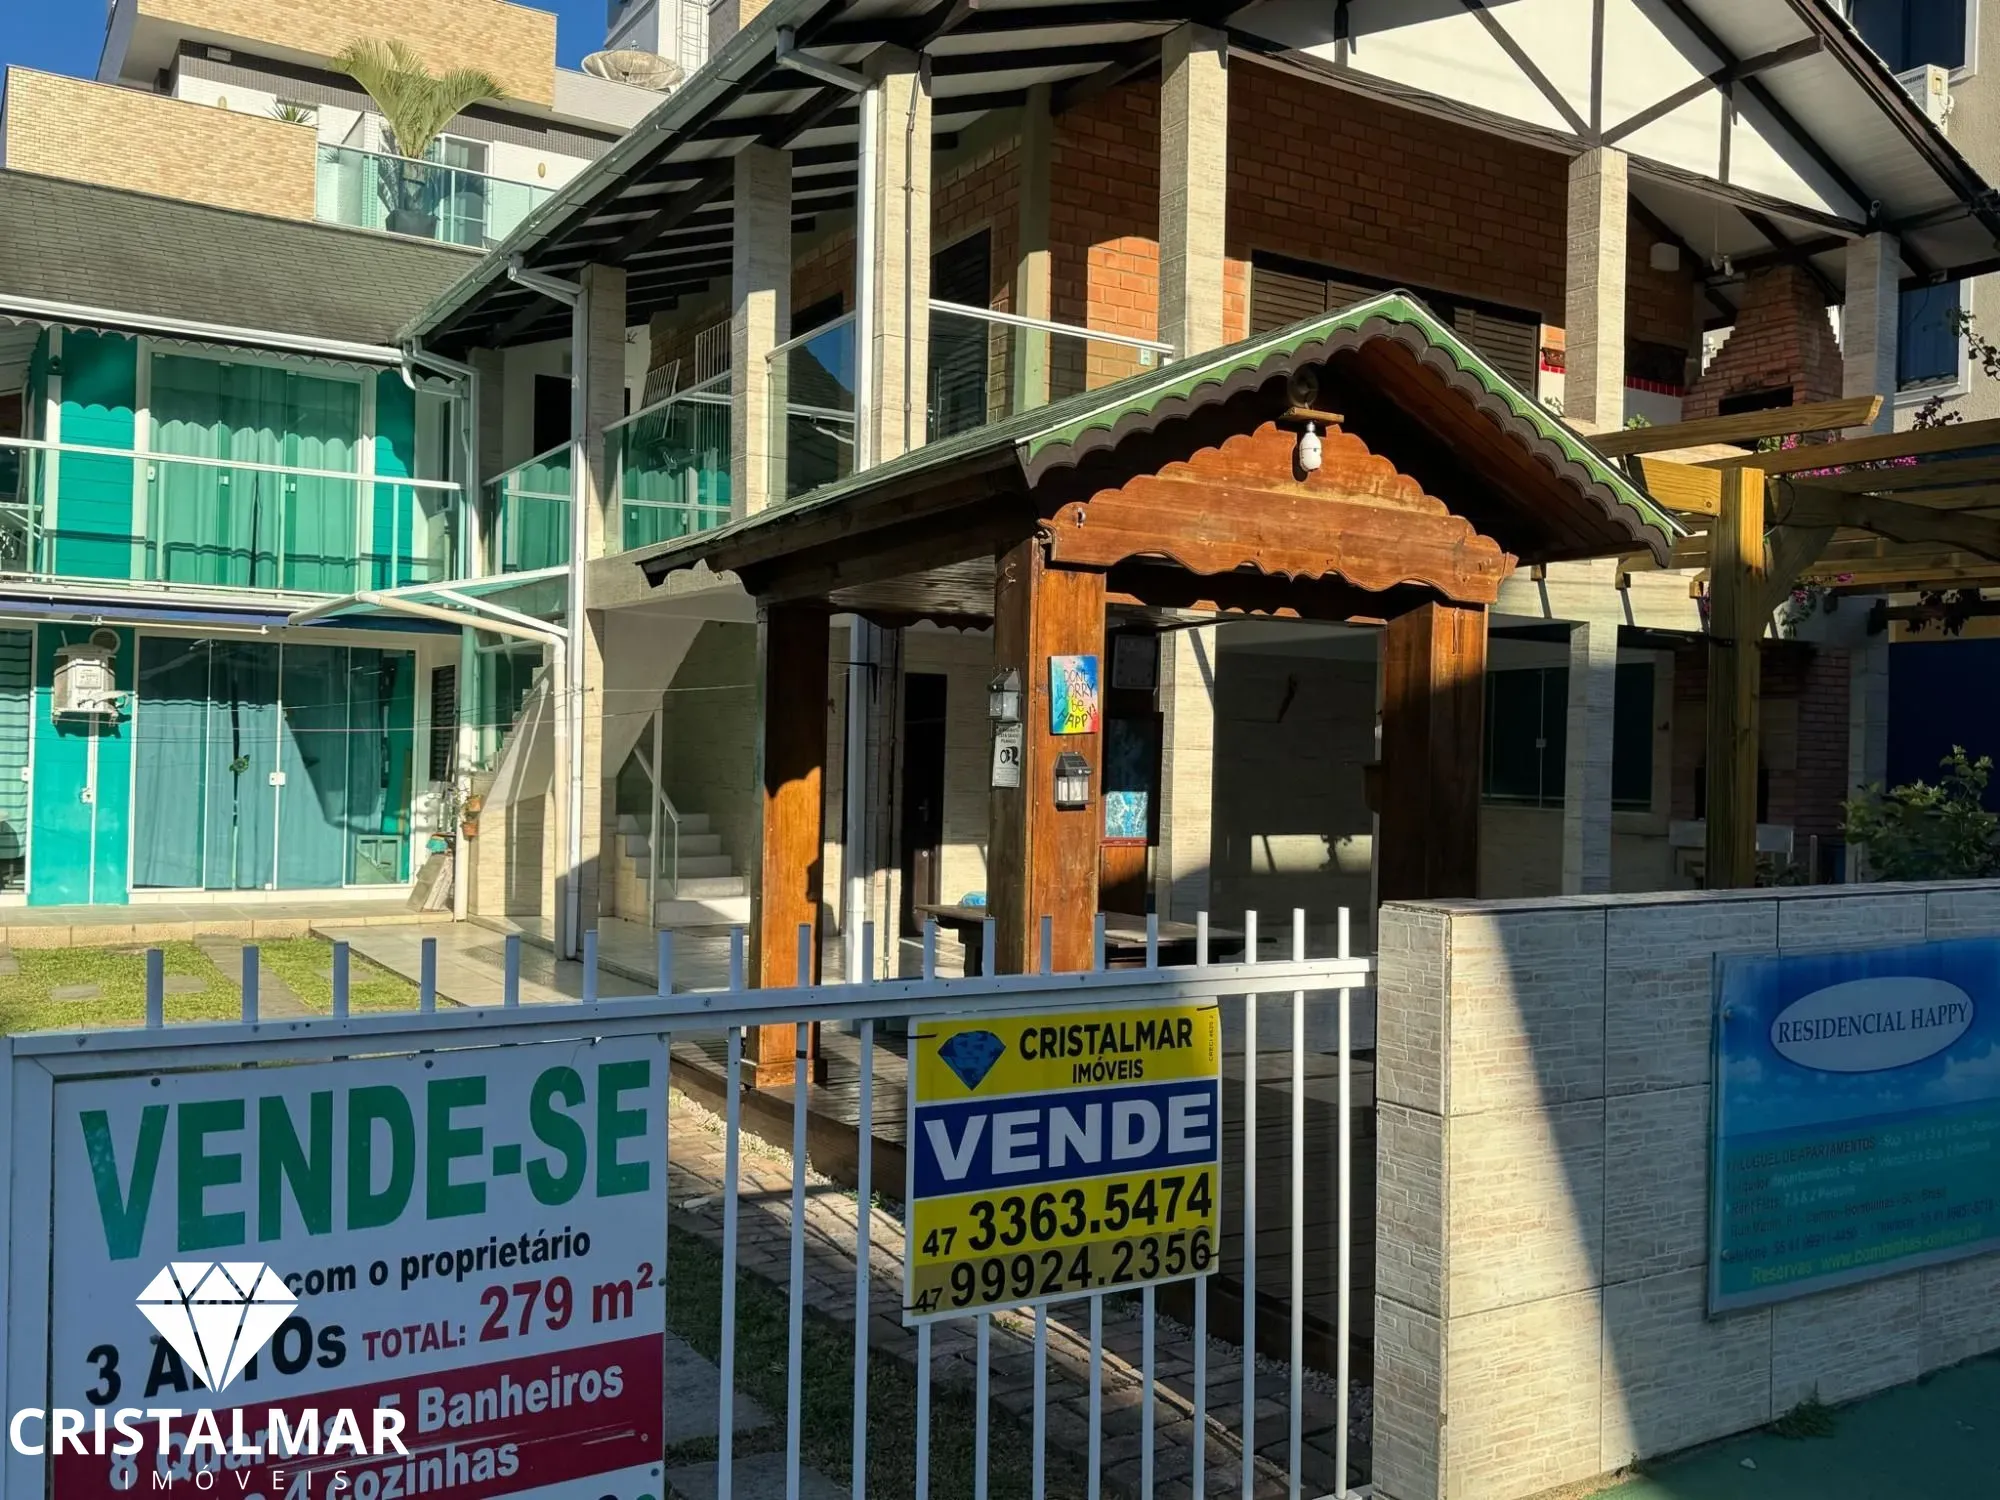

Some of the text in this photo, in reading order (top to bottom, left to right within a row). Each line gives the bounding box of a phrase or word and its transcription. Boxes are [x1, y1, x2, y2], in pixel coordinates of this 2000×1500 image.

[1019, 1017, 1193, 1060] CRISTALMAR
[1777, 1001, 1969, 1044] RESIDENCIAL HAPPY
[1072, 1056, 1144, 1084] IMÓVEIS
[79, 1058, 651, 1261] VENDE-SE
[923, 1092, 1211, 1181] VENDE
[922, 1171, 1212, 1257] 47 3363.5474
[284, 1263, 357, 1299] com
[368, 1260, 389, 1286] o
[400, 1225, 591, 1291] proprietário
[914, 1229, 1211, 1313] 47 99924.2356
[85, 1343, 122, 1406] 3
[144, 1314, 348, 1398] AOs
[361, 1319, 466, 1361] TOTAL:
[478, 1275, 574, 1343] 279
[417, 1363, 625, 1434] Banheiros
